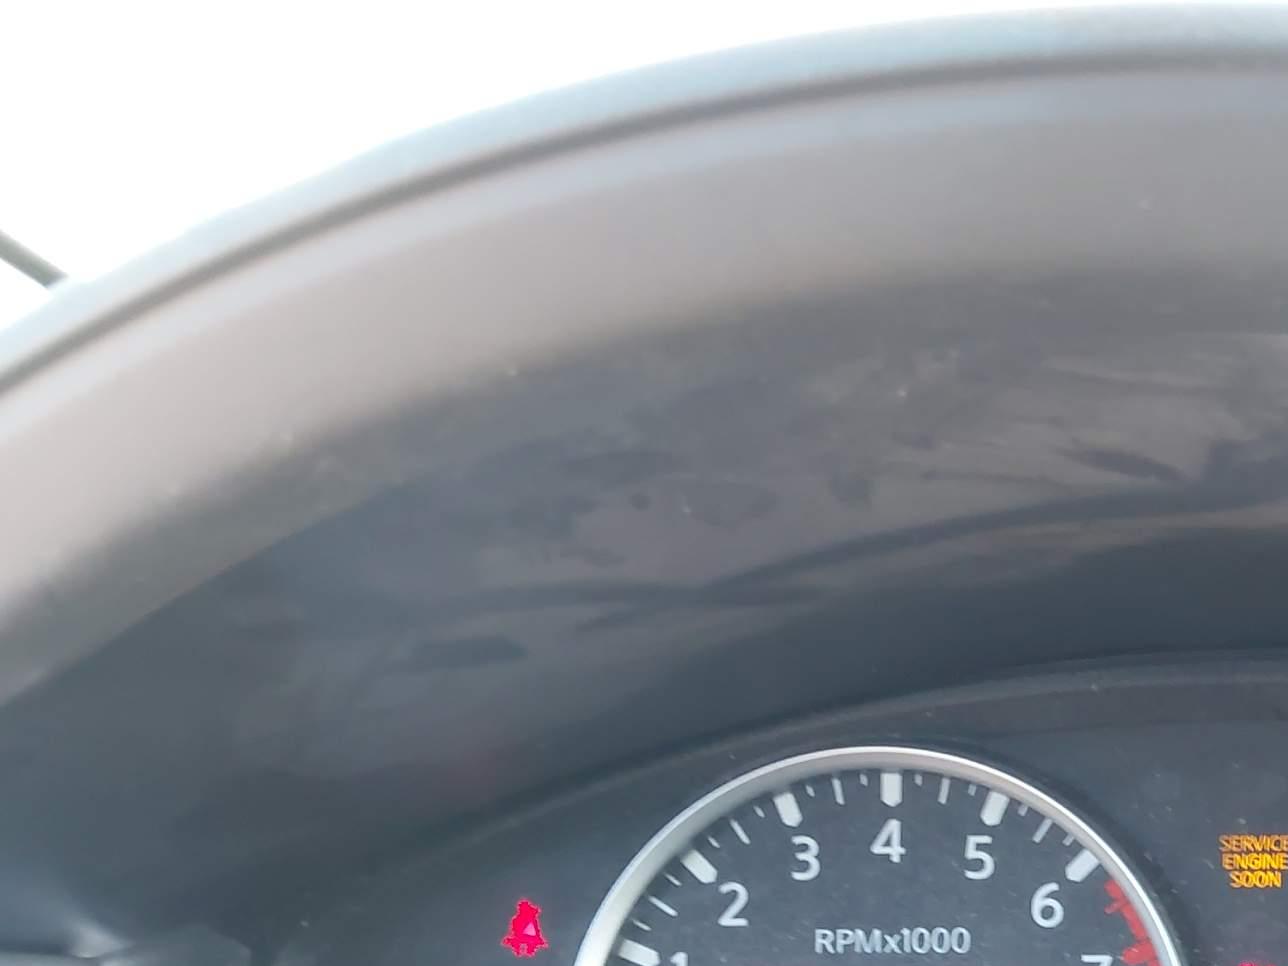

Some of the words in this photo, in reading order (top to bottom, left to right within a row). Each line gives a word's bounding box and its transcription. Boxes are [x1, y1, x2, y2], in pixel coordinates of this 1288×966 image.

[791, 837, 820, 880] 3
[870, 819, 906, 863] 4
[965, 836, 994, 879] 5
[1229, 871, 1281, 888] SOON
[717, 883, 749, 927] 2
[1030, 883, 1064, 928] 6
[815, 927, 972, 955] RPMx1000
